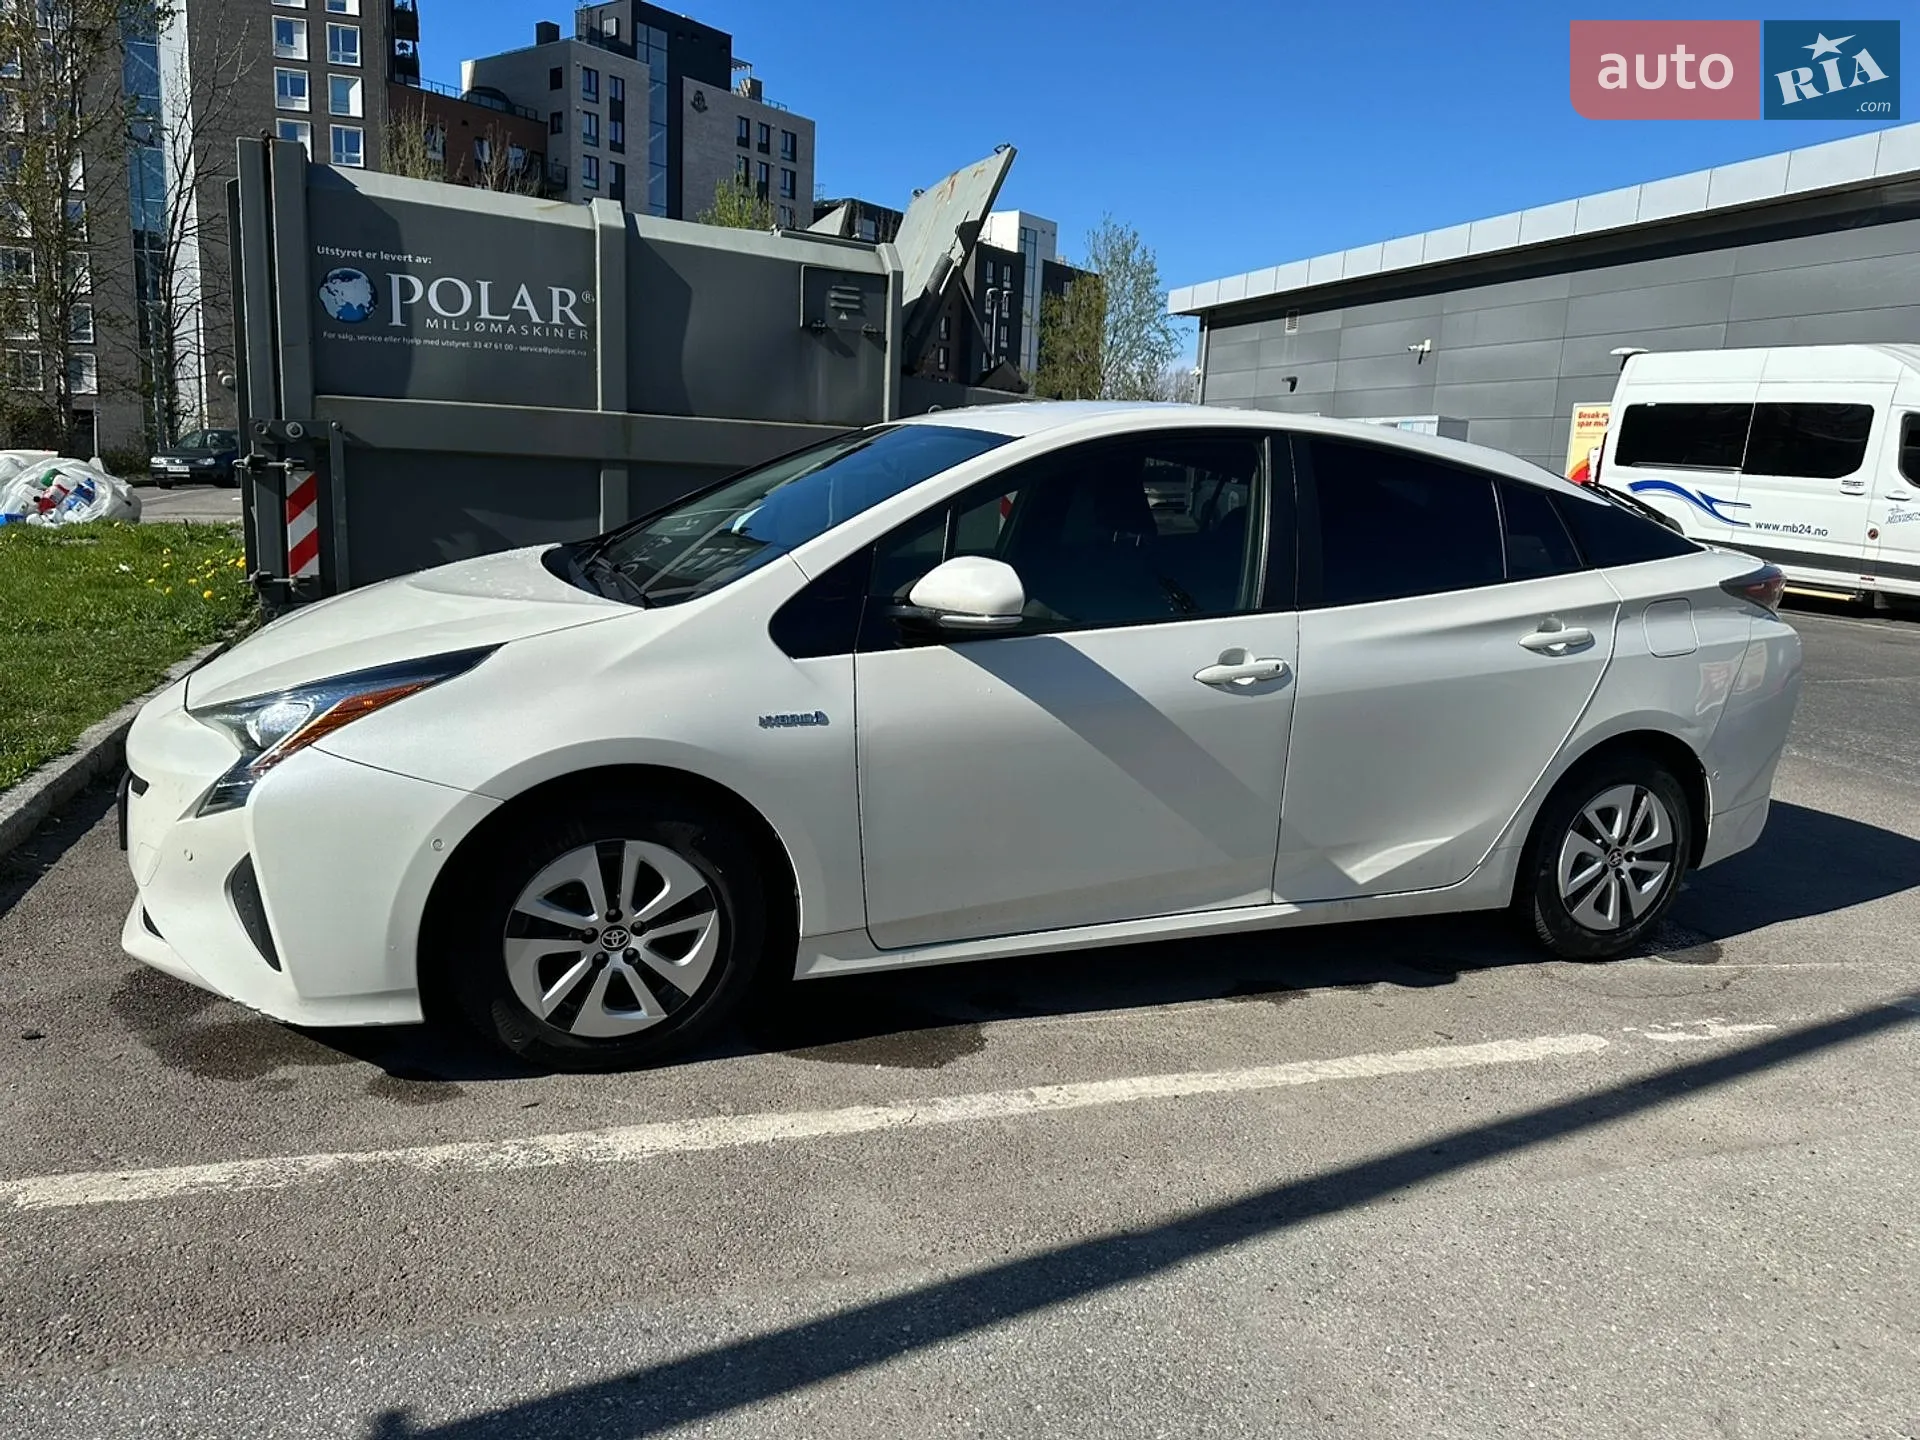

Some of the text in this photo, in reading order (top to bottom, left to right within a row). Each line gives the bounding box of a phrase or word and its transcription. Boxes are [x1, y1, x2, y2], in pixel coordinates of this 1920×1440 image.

[316, 245, 432, 265] Utstyret er levert av:
[425, 317, 589, 341] MILJØMASKINER
[1755, 521, 1829, 537] www.mb24.no
